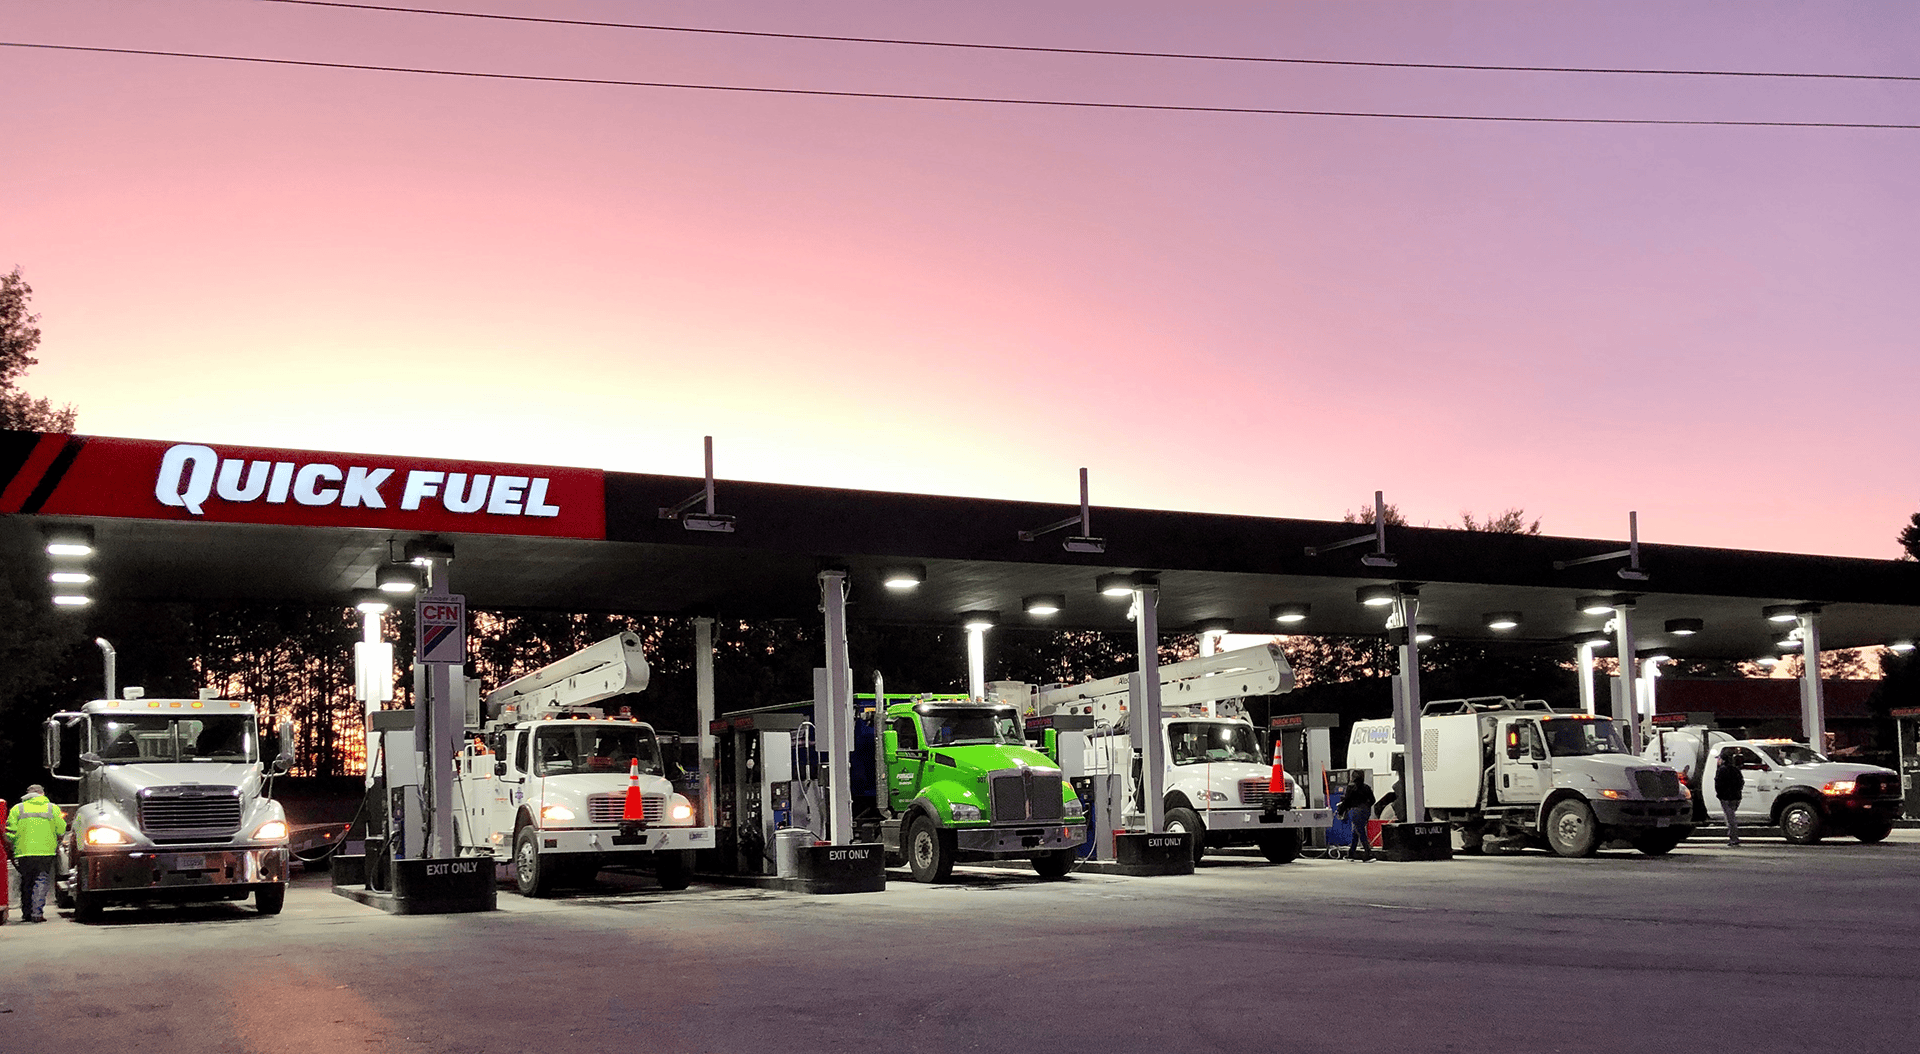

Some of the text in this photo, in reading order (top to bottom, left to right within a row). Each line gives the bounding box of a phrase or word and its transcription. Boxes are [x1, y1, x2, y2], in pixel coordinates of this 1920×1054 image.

[154, 443, 560, 517] QUICK FUEL
[423, 605, 458, 620] CFN
[1149, 837, 1182, 847] EXIT ONLY
[829, 849, 870, 860] EXIT ONLY
[426, 861, 478, 876] EXIT ONLY
